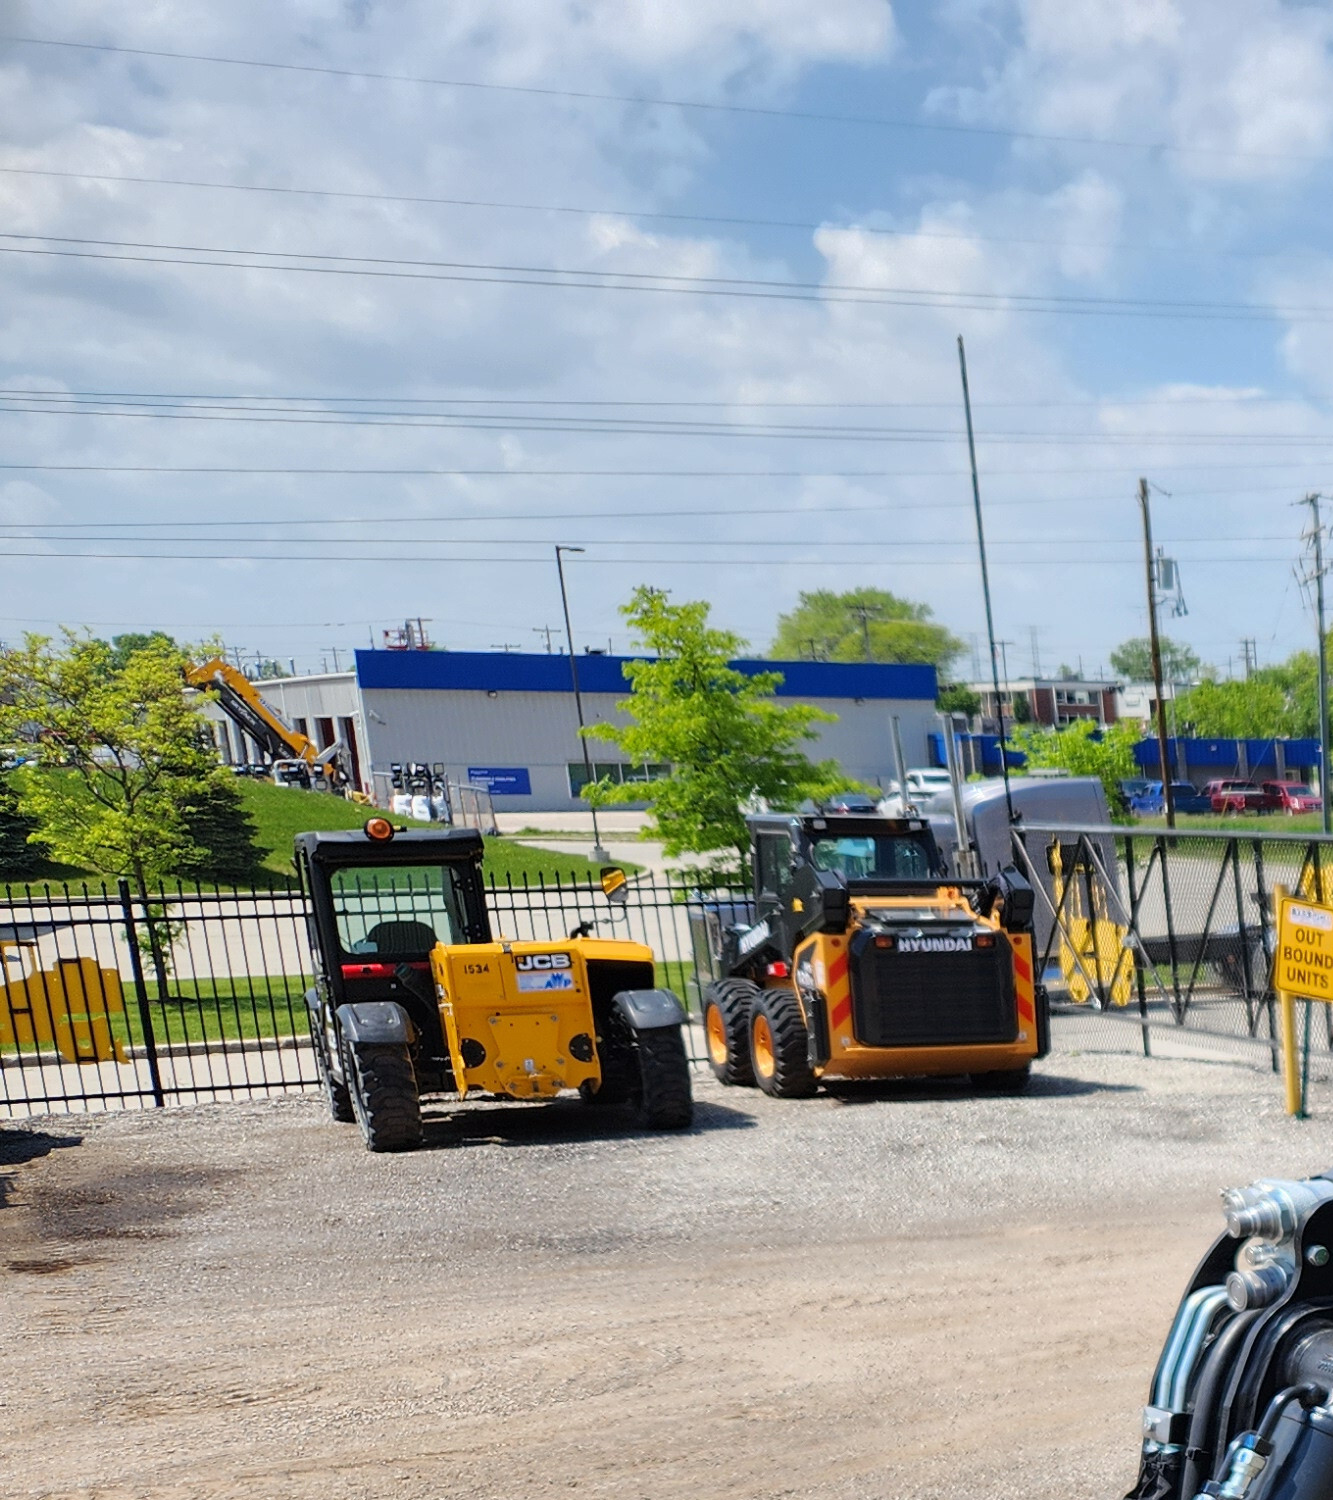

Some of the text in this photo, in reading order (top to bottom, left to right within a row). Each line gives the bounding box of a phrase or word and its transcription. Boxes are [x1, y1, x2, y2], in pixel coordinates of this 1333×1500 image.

[899, 938, 973, 952] HYUNDAI
[1295, 929, 1324, 947] OUT
[517, 954, 571, 971] JCB
[1283, 945, 1333, 970] BOUND
[464, 964, 490, 975] 1534
[1286, 966, 1329, 989] UNITS
